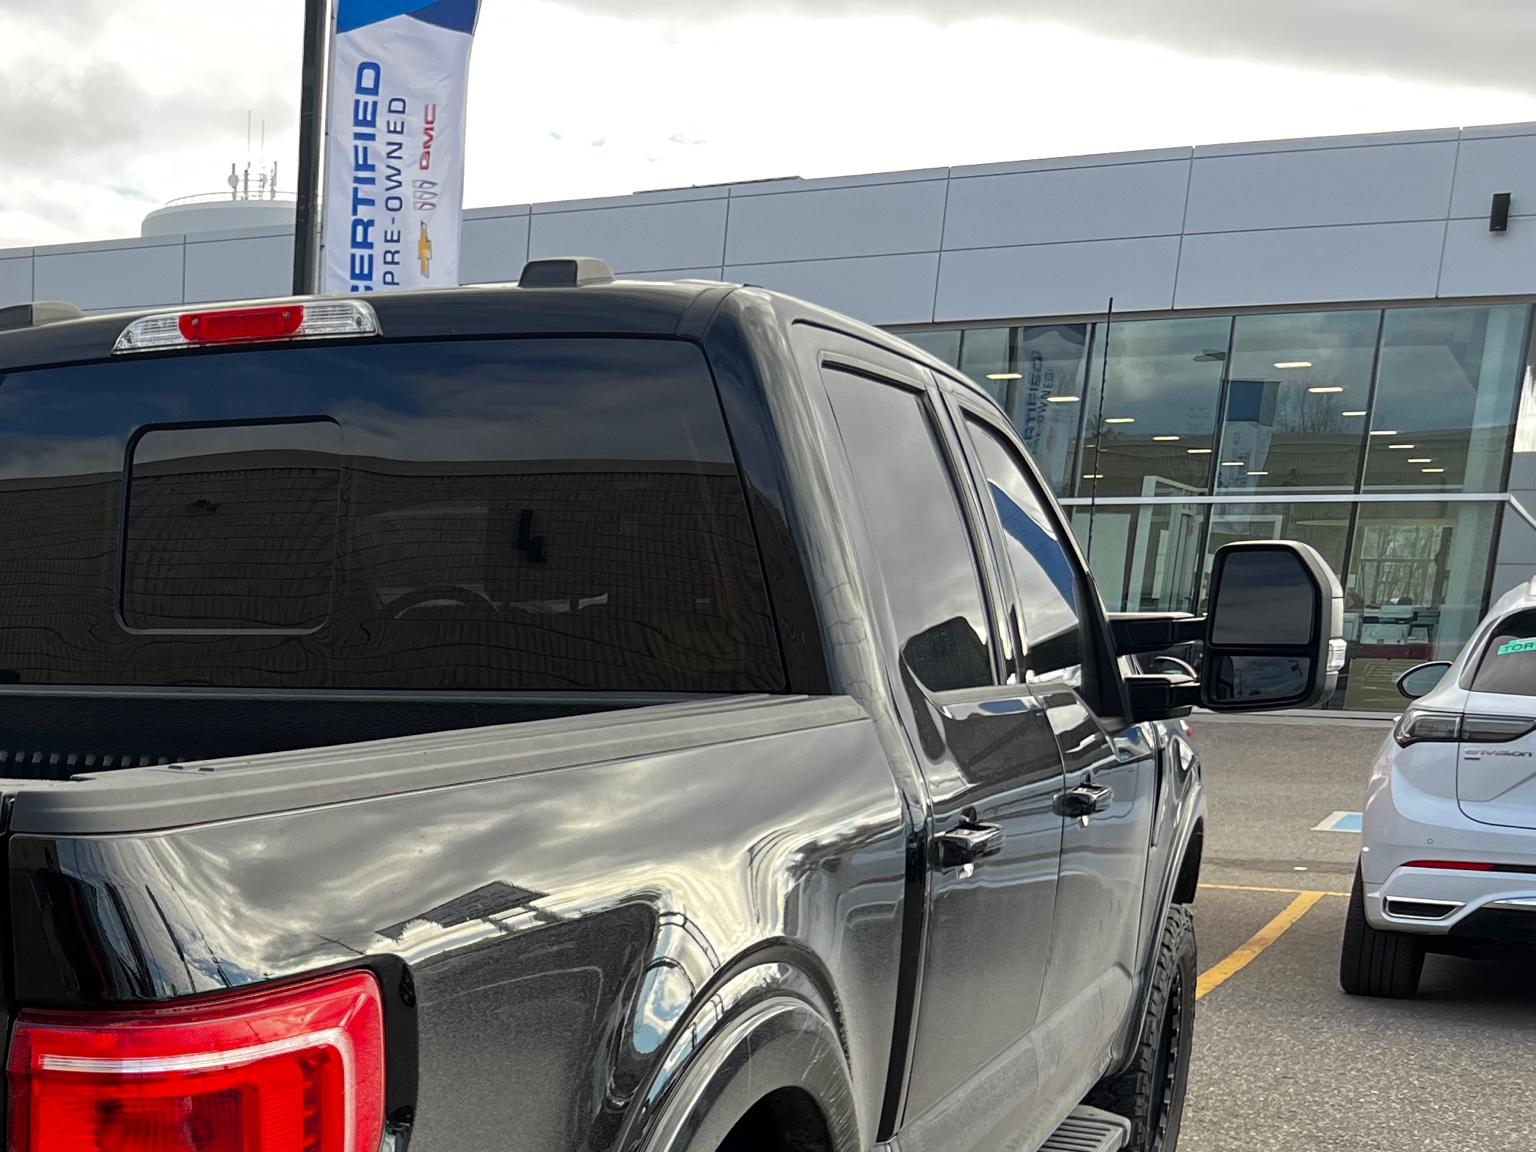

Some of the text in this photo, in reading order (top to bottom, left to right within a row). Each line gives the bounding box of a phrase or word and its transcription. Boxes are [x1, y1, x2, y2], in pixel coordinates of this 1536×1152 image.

[350, 61, 381, 292] ERTIFIED
[383, 98, 406, 286] PRE-OWNED
[419, 104, 436, 170] GMC
